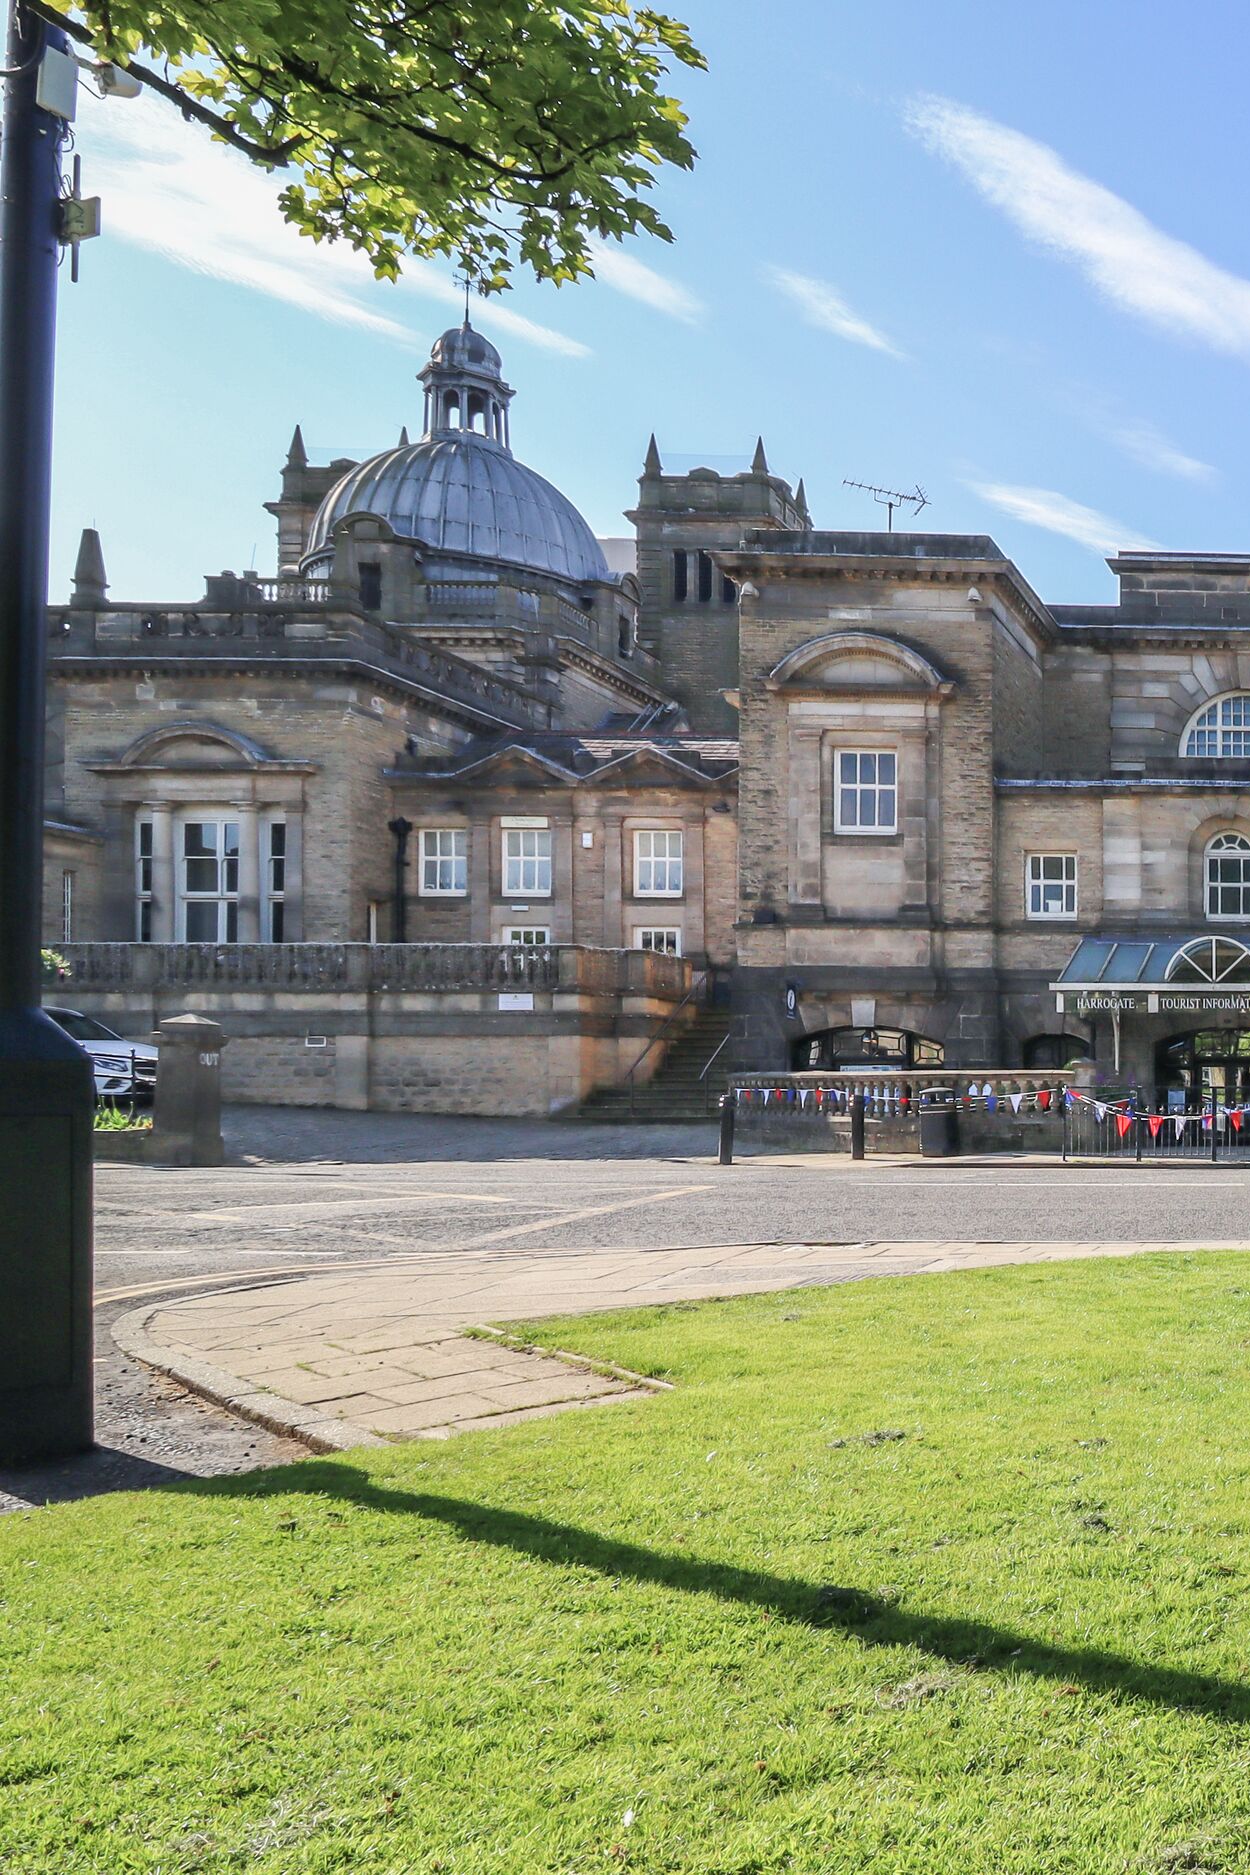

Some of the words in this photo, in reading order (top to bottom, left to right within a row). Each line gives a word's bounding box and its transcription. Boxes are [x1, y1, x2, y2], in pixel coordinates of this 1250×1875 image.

[1077, 998, 1135, 1009] HARROGATE
[1160, 998, 1201, 1009] TOURIST
[200, 1053, 219, 1065] OUT
